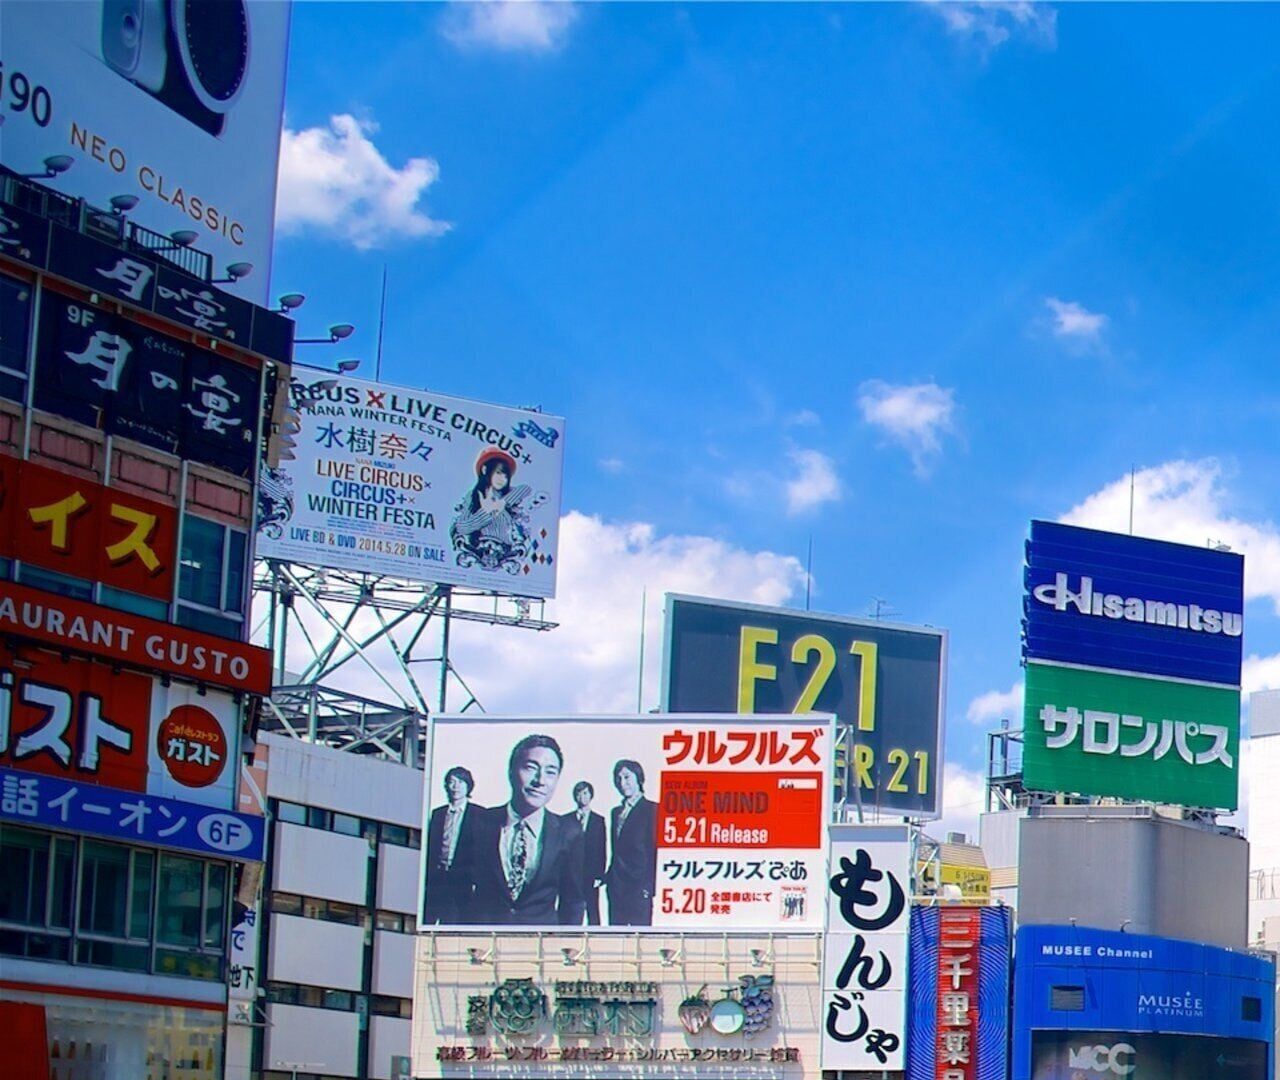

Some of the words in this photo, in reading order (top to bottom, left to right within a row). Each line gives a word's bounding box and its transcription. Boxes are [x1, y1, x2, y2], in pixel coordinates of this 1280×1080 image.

[71, 122, 125, 172] NEO
[138, 166, 245, 247] CLASSIC
[96, 257, 228, 332] 月の宴
[66, 303, 96, 328] 9F
[64, 330, 242, 435] 月の宴
[307, 405, 347, 417] NANA
[351, 406, 408, 428] WINTER
[410, 420, 453, 442] FESTA
[391, 394, 447, 425] LIVE
[315, 422, 434, 462] 水樹奈々
[316, 458, 355, 480] LIVE
[307, 494, 378, 521] WINTER
[383, 506, 436, 530] FESTA
[290, 526, 312, 543] LIVE
[337, 534, 357, 549] DVD
[358, 537, 407, 556] 2014.5.28
[407, 544, 422, 558] ON
[422, 546, 446, 562] SALE
[1033, 571, 1243, 638] Hisamitsu
[145, 636, 249, 681] GUSTO
[0, 672, 132, 771] スト
[1039, 704, 1234, 769] サロンパス
[167, 738, 221, 767] ガスト
[663, 727, 824, 766] ウルフルズ
[887, 748, 930, 795] 21
[664, 790, 707, 814] ONE
[711, 790, 770, 814] MIND
[209, 821, 242, 846] 6F
[664, 817, 708, 844] 5.21
[710, 823, 769, 844] Release
[662, 859, 808, 882] ウルフルズぴあ
[661, 888, 705, 914] 5.20
[710, 891, 773, 903] 全国書店にて
[710, 904, 731, 915] 発売
[826, 848, 906, 1064] もんじゃ
[1042, 945, 1092, 957] MUSEE
[1097, 946, 1153, 959] Channel
[553, 997, 658, 1036] 西村
[1138, 1007, 1204, 1017] PLATINUM
